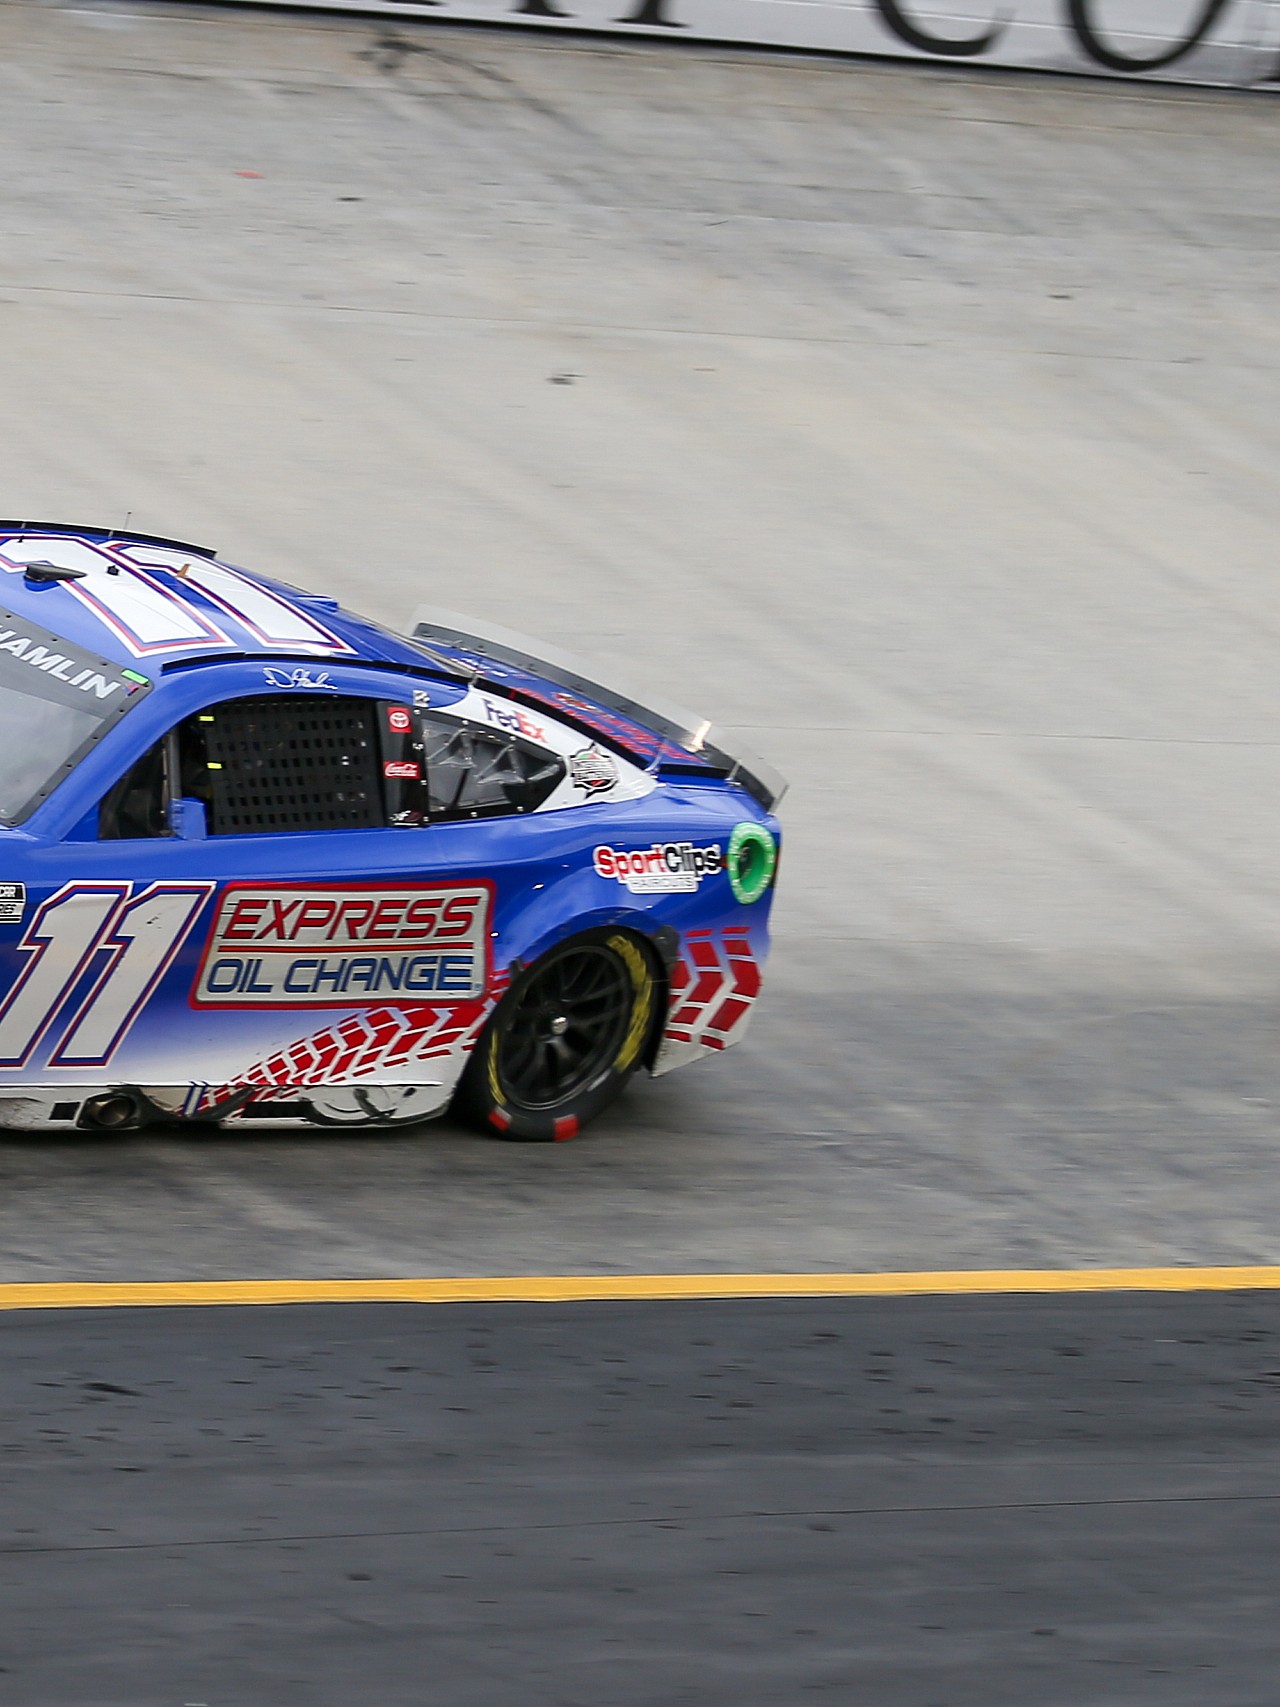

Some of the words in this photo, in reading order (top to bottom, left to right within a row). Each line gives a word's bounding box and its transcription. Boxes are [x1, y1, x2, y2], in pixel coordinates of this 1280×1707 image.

[482, 698, 549, 743] FedEx
[632, 877, 694, 888] HAIRCUTS
[221, 895, 482, 940] EXPRESS
[206, 958, 274, 994] OIL
[283, 955, 475, 992] CHANGE
